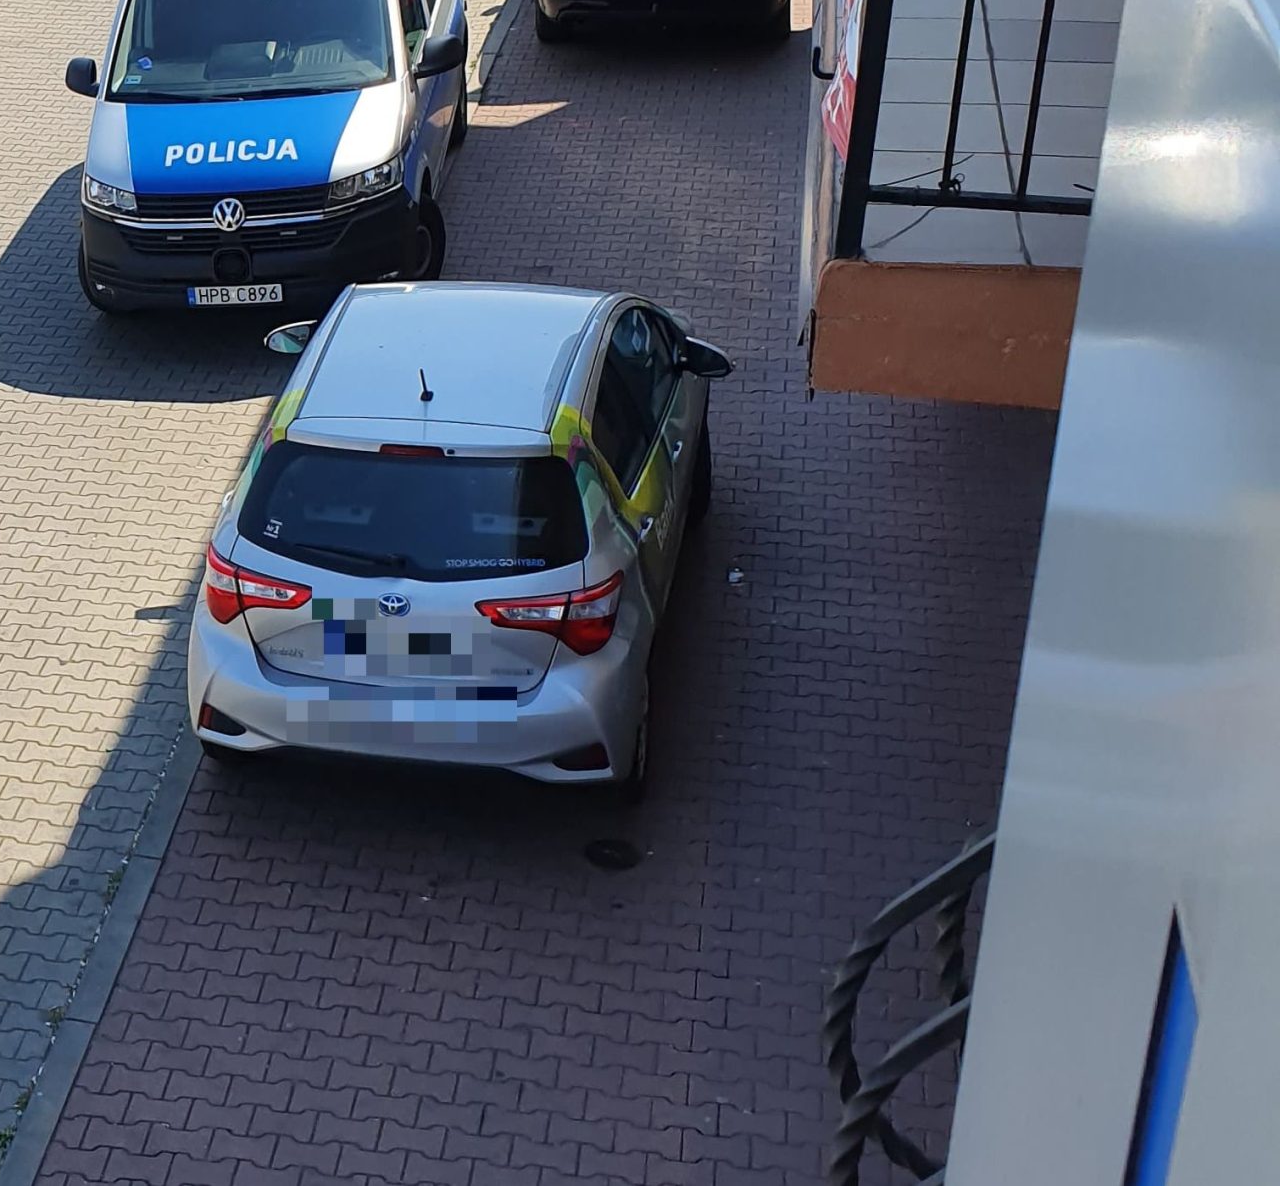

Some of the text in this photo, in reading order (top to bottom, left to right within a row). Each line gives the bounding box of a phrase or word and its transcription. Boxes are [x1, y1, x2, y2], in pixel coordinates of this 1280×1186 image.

[165, 138, 298, 167] POLICJA
[199, 286, 278, 303] HPB C896
